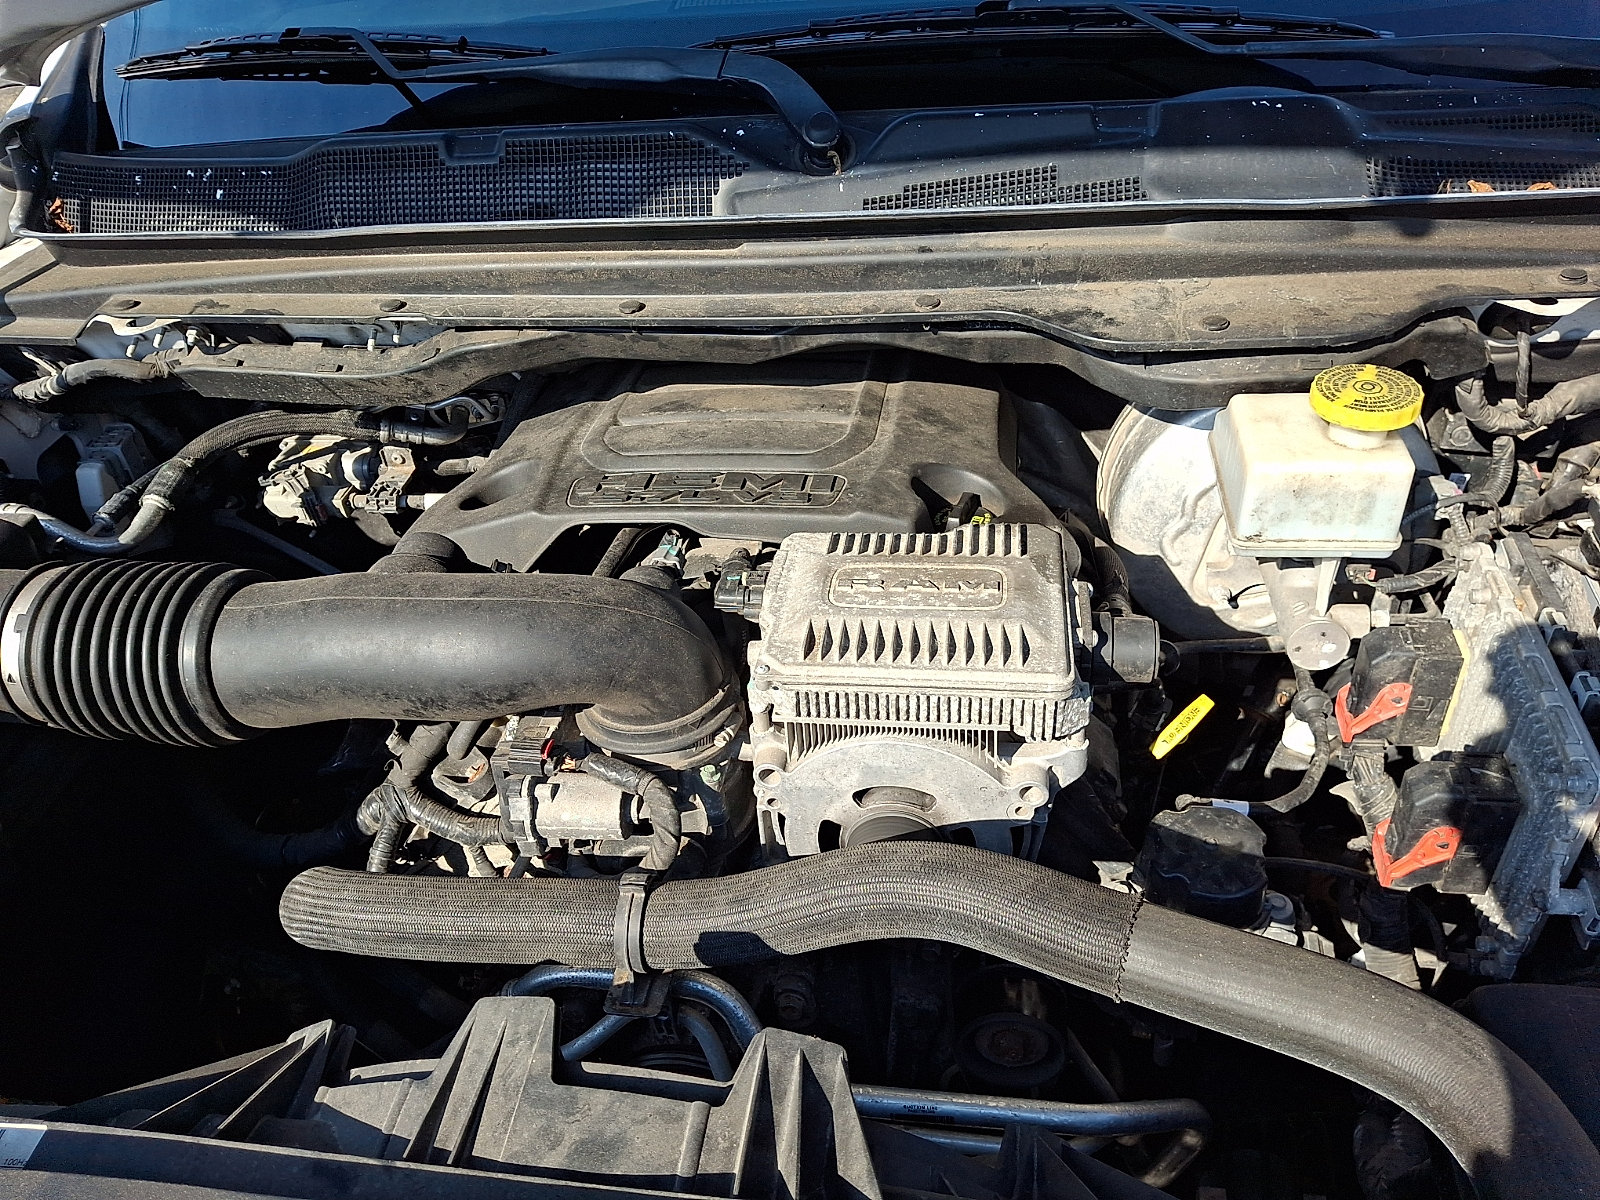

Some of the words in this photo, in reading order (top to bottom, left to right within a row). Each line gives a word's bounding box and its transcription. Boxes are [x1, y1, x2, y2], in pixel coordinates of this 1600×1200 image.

[577, 473, 838, 493] HEMI
[837, 578, 1001, 592] RAM
[1175, 708, 1200, 732] ENGINE
